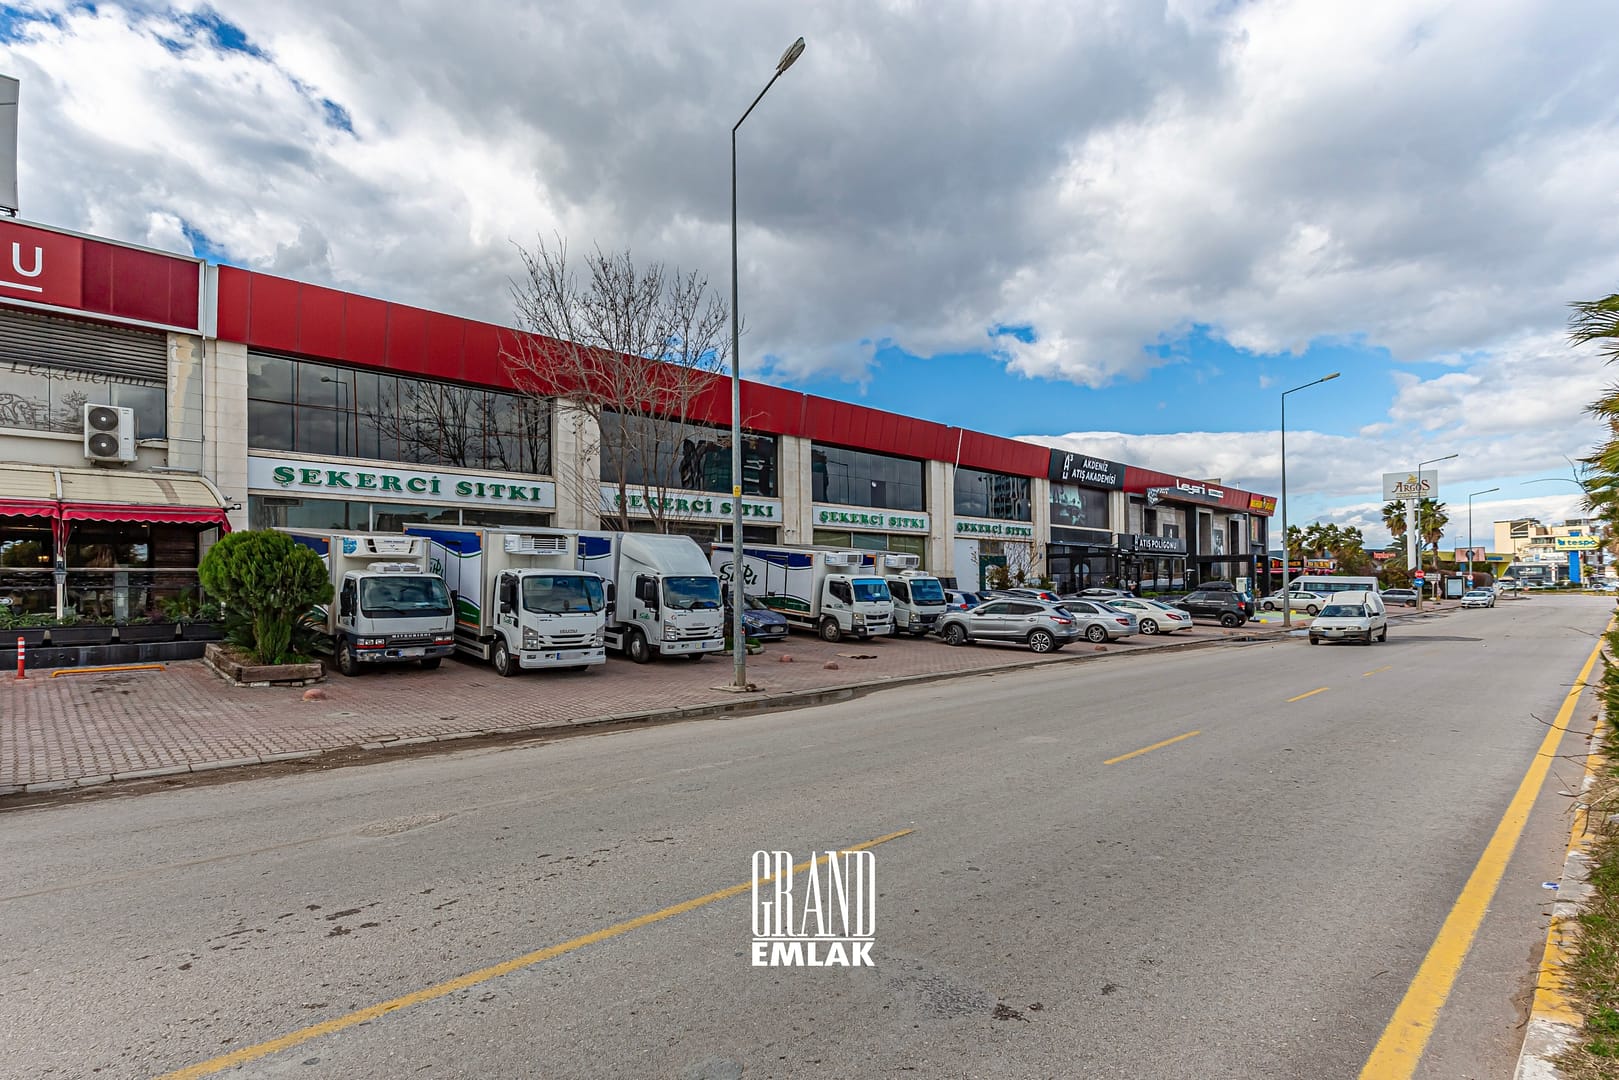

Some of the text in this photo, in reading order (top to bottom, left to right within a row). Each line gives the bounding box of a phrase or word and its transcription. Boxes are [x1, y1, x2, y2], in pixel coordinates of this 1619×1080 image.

[273, 466, 541, 501] ŞEKERCİ SITKI
[720, 502, 773, 518] STKI
[819, 510, 925, 529] ŞEKERCİ SITKI
[956, 522, 1032, 537] ŞEKERCİ SITKI
